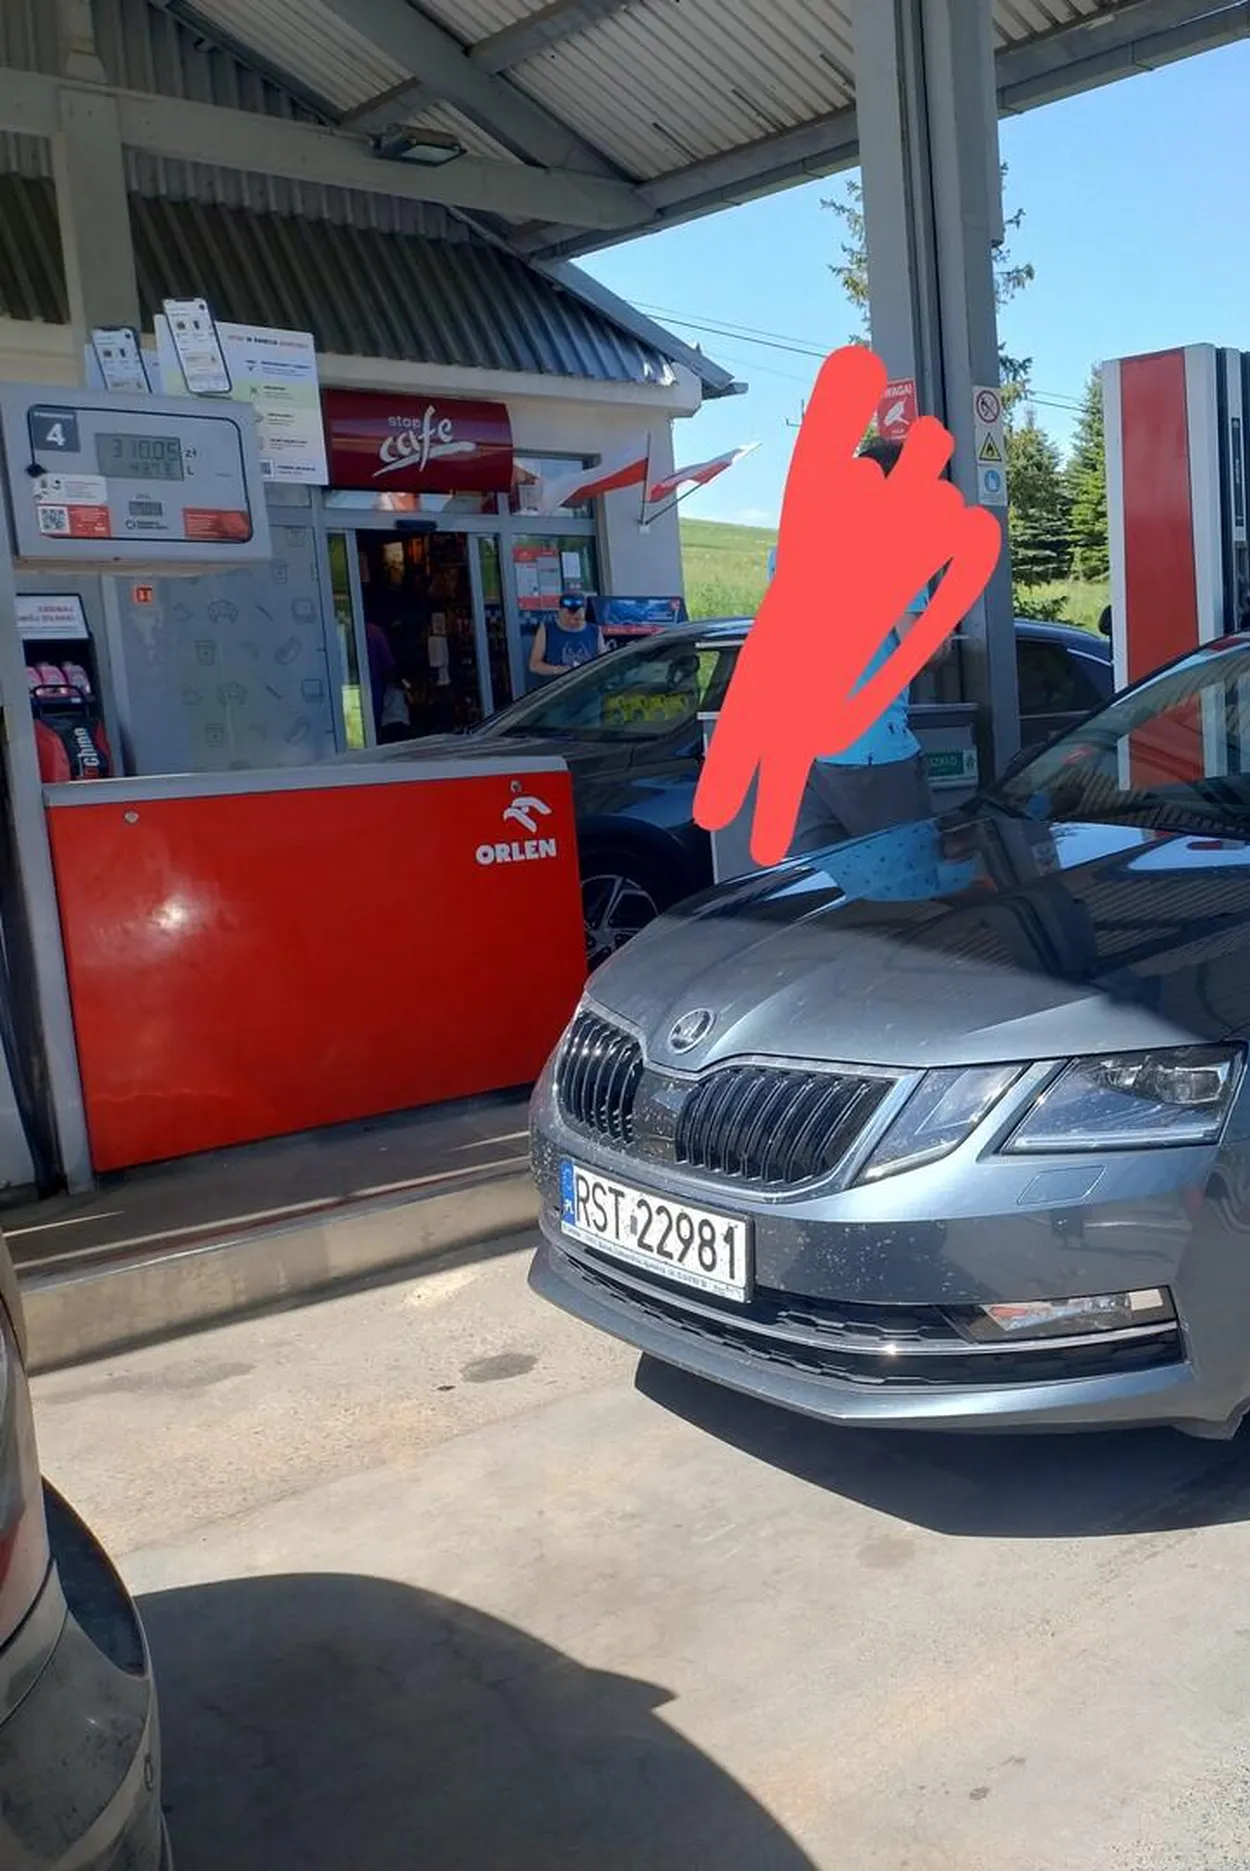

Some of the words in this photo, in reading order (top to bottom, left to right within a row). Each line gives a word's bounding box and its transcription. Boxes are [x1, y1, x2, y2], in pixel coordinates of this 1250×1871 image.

[45, 423, 66, 446] 4
[387, 416, 421, 430] stop
[475, 838, 557, 865] ORLEN
[575, 1173, 626, 1240] RST
[636, 1198, 736, 1281] 22981
